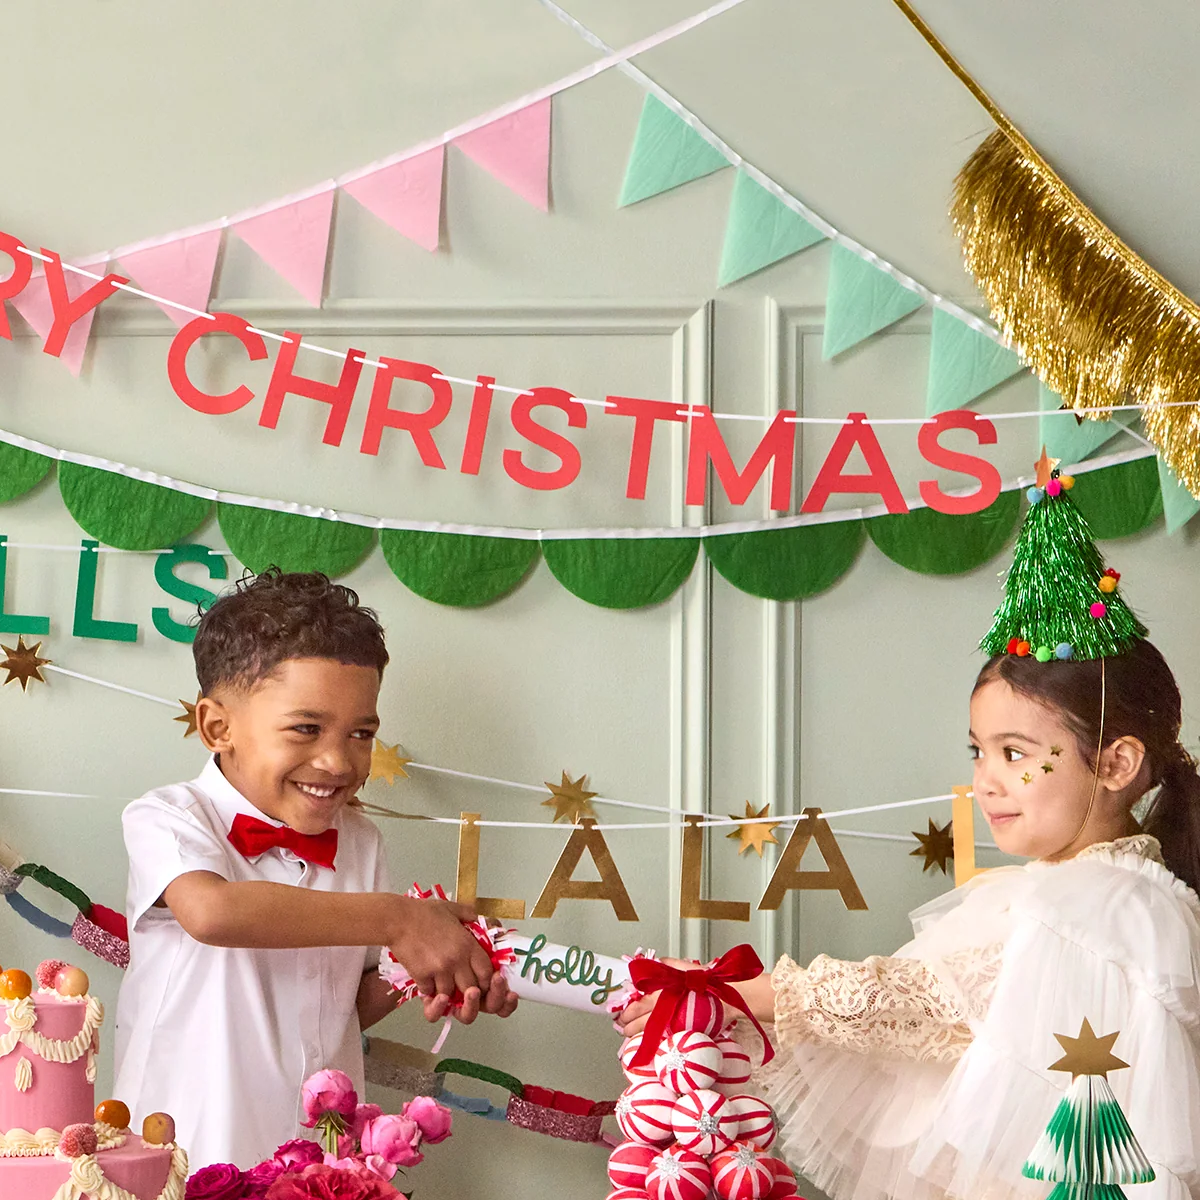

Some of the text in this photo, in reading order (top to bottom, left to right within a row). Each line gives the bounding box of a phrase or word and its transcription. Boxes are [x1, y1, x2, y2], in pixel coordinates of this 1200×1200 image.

[167, 312, 1002, 515] CHRISTMAS
[456, 811, 639, 921] LA
[679, 807, 869, 922] LA
[514, 934, 623, 1005] holly
